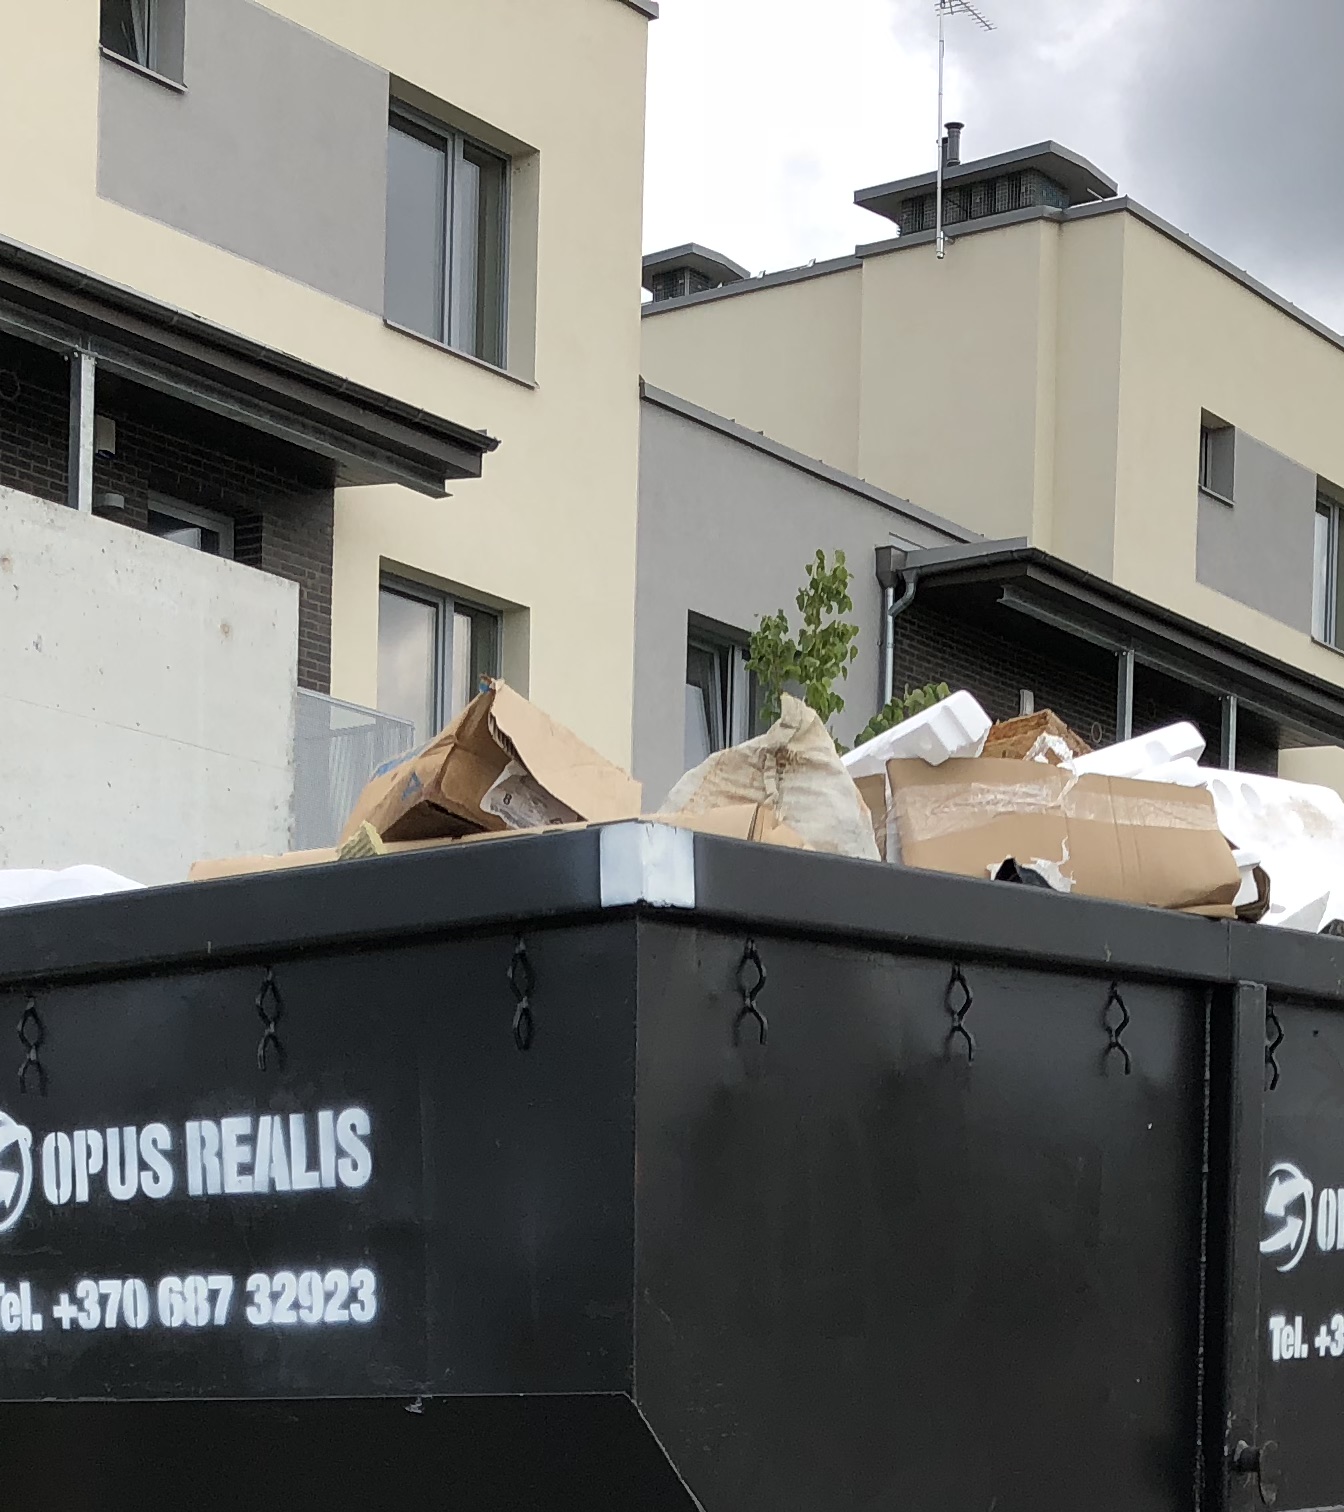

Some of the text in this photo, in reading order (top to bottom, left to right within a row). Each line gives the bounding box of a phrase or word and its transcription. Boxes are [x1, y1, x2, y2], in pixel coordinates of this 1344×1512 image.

[41, 1107, 372, 1205] OPUS REALIS
[52, 1277, 150, 1331] +370
[157, 1273, 234, 1328] 687
[245, 1268, 377, 1326] 32923
[1268, 1314, 1309, 1361] Tel.
